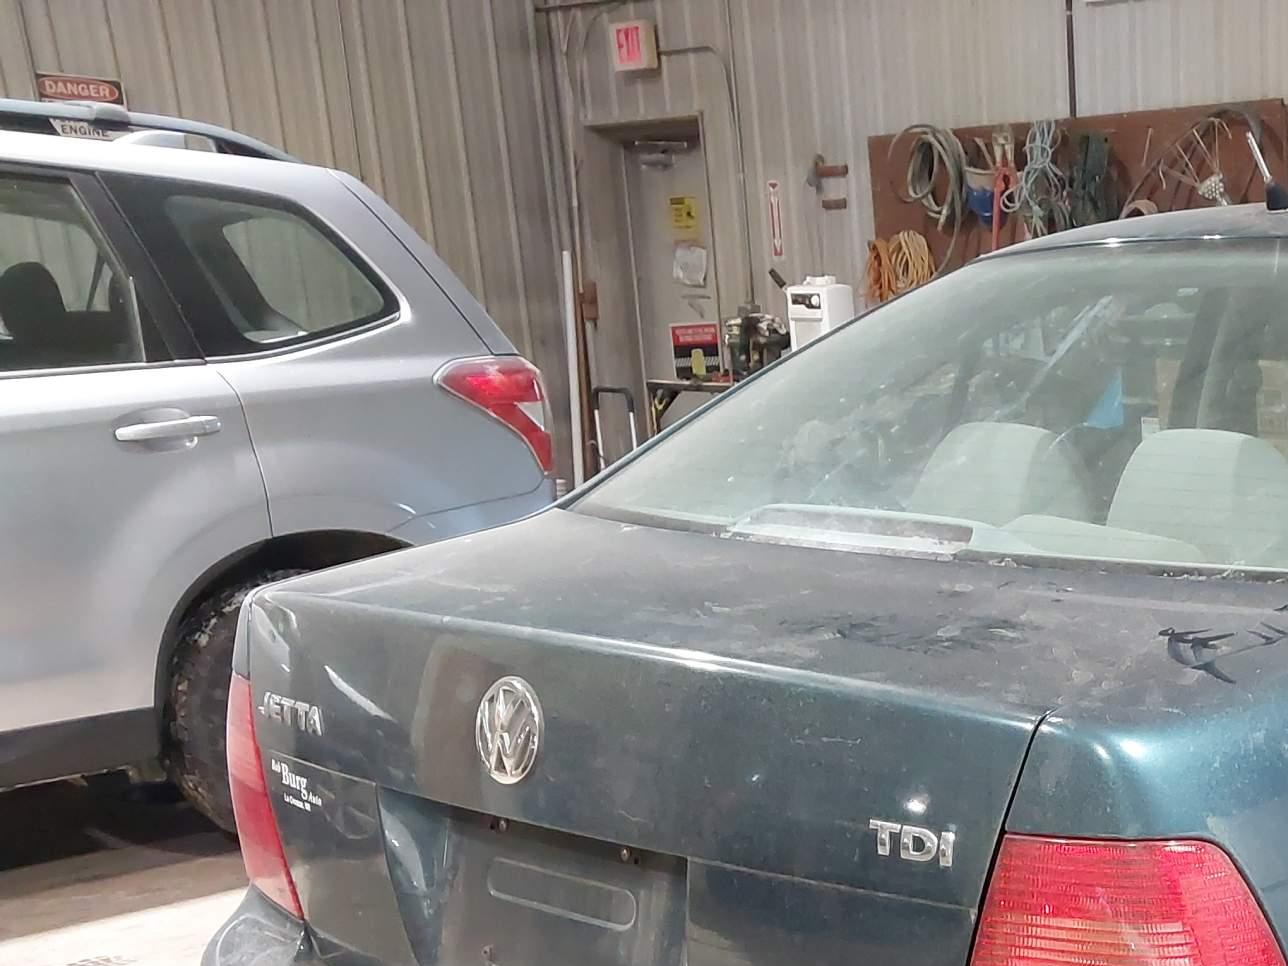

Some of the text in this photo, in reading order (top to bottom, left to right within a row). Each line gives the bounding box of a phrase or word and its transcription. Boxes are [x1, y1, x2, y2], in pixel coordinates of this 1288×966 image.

[615, 26, 641, 64] EXIT
[43, 80, 111, 98] DANGER
[258, 691, 325, 736] JETTA
[281, 763, 308, 801] Burg
[868, 819, 956, 867] TDI
